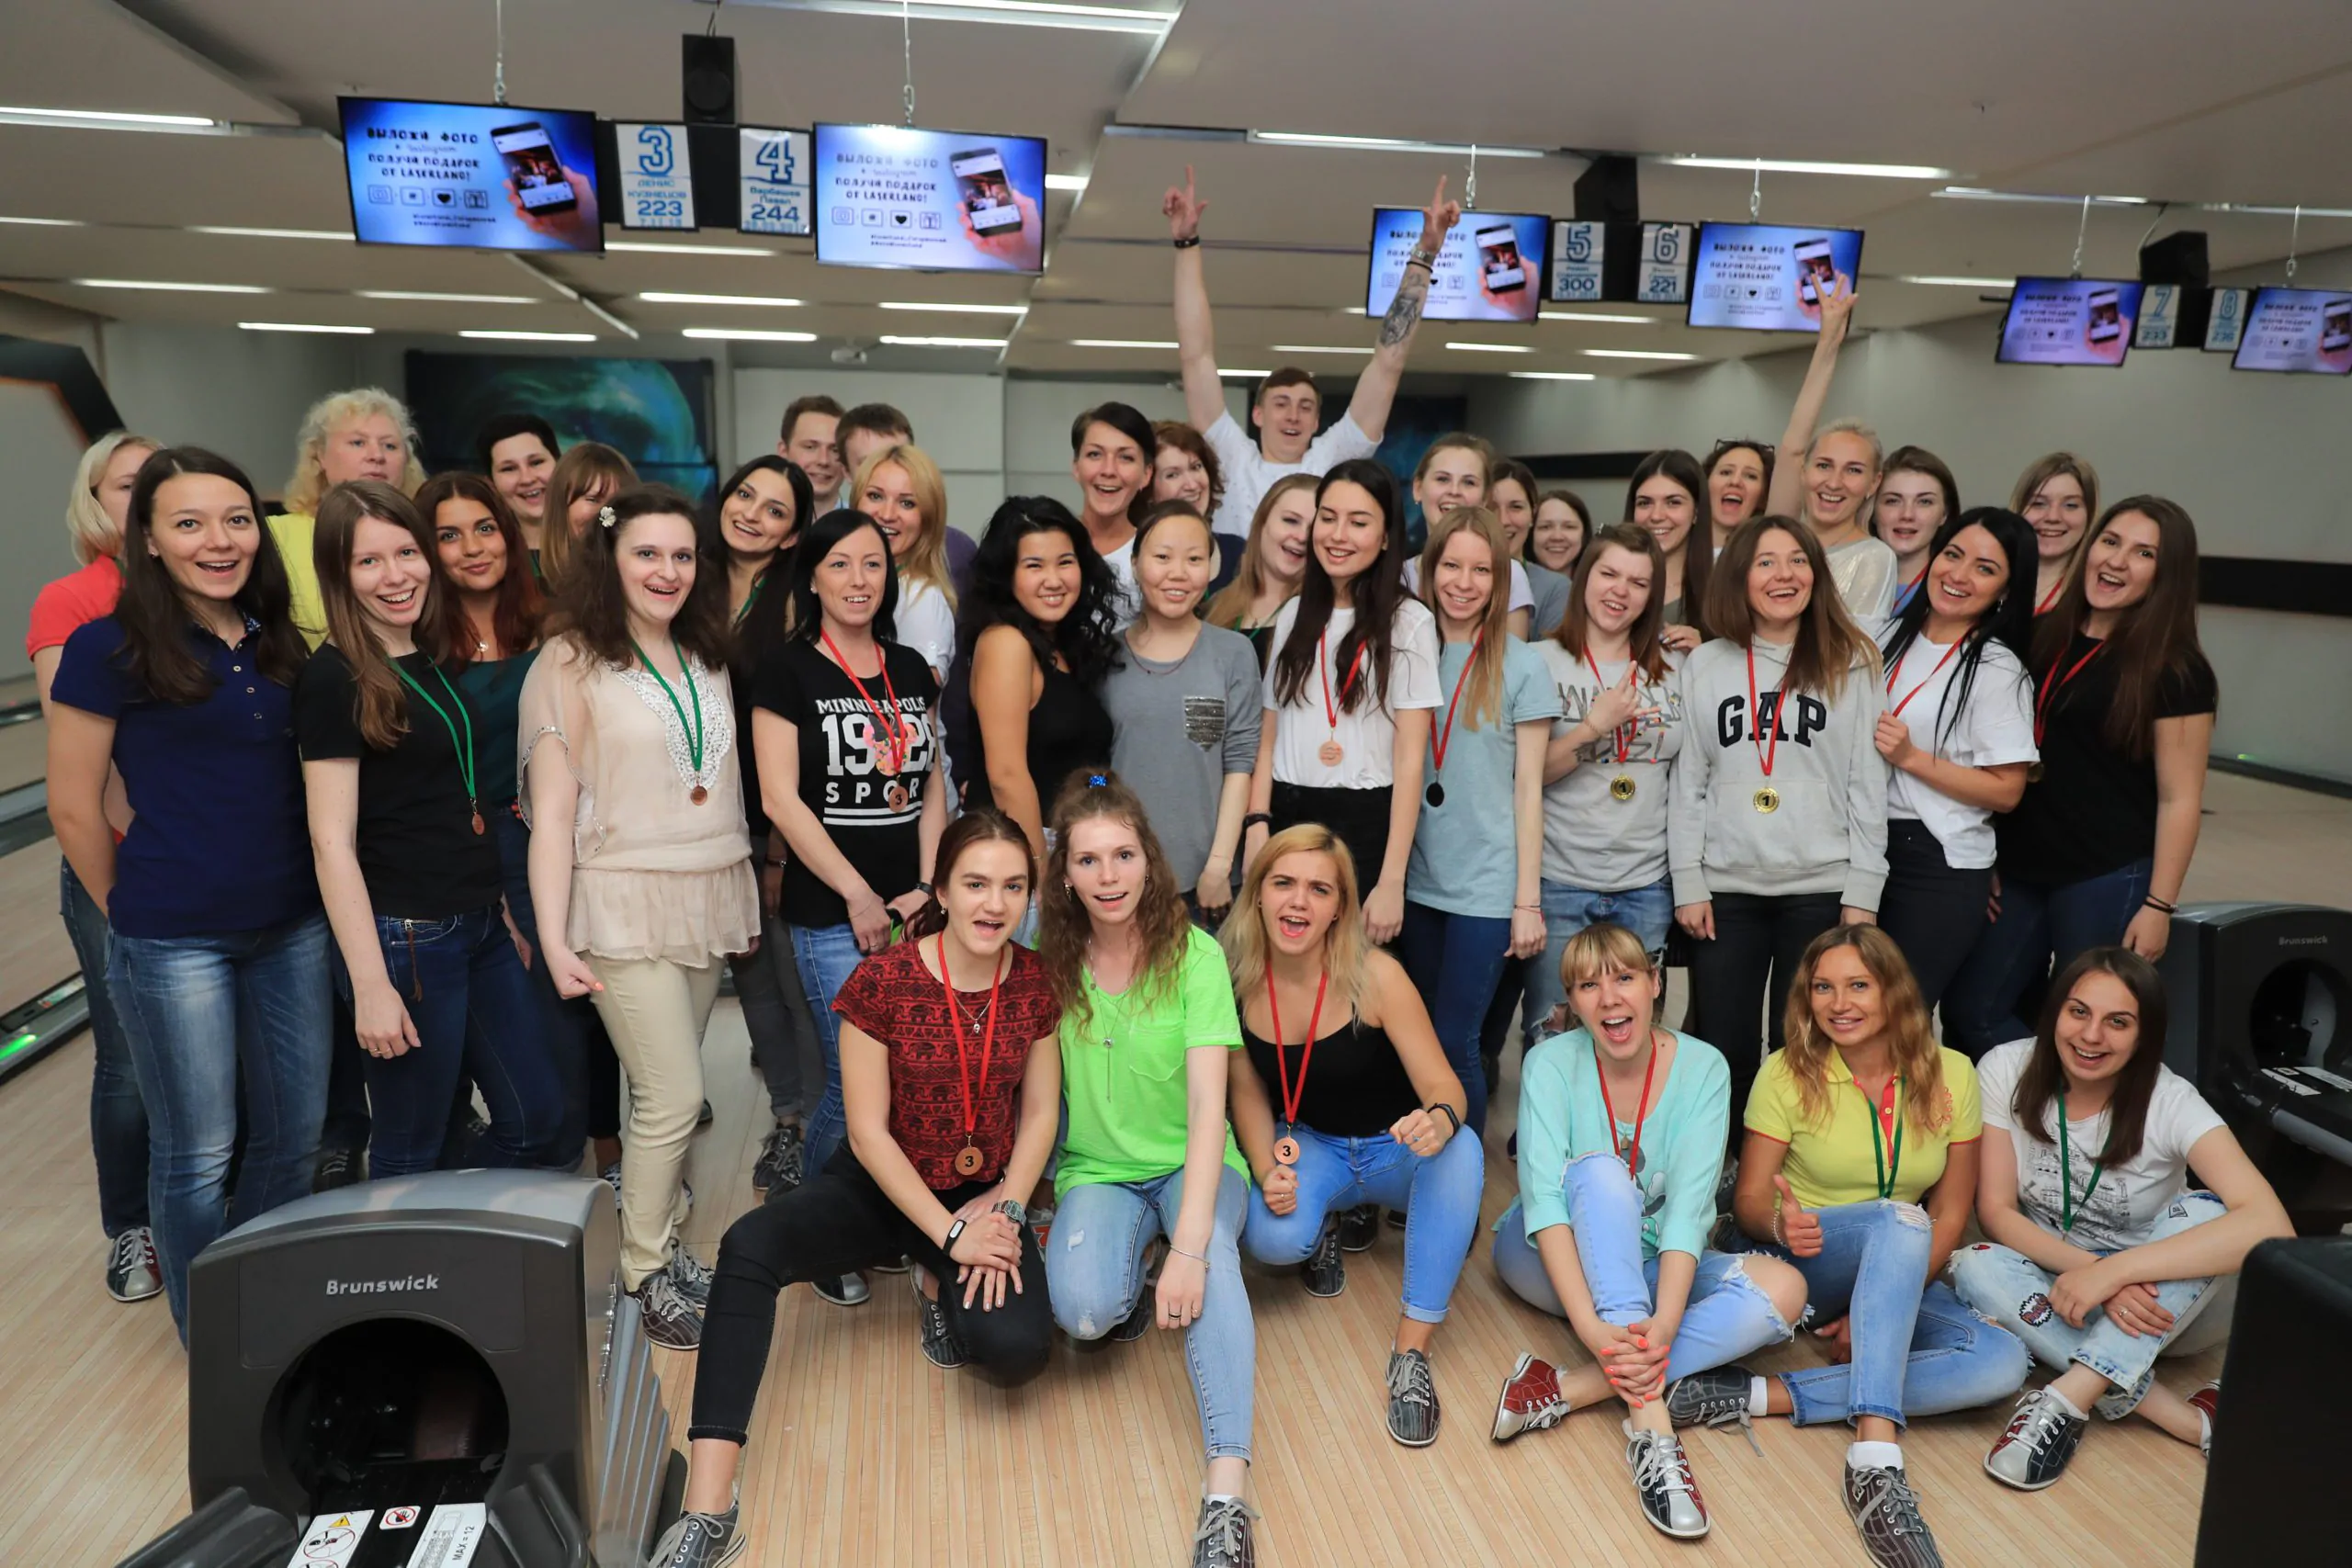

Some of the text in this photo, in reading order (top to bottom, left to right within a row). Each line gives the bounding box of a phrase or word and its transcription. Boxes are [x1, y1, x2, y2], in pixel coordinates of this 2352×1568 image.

[367, 127, 479, 144] ВЫЛОЖИ ФОТО
[638, 125, 673, 177] 3
[368, 153, 481, 169] ПОЛУЧИ ПОДАРОК
[755, 138, 796, 184] 4
[836, 152, 939, 169] ВЫЛОЖИ ФОТО
[381, 168, 470, 182] ОТ LASERLAND!
[835, 177, 937, 191] ПОЛУЧИ ПОДАРОК
[845, 190, 928, 203] ОТ LASERLAND!
[638, 199, 684, 217] 223
[751, 203, 800, 222] 244
[1447, 232, 1467, 242] ОТО
[1566, 224, 1591, 263] 5
[1654, 224, 1679, 264] 6
[1559, 277, 1595, 291] 300
[1649, 277, 1677, 293] 221
[2154, 285, 2172, 316] 7
[2220, 289, 2238, 320] 8
[1717, 692, 1826, 748] GAP
[1761, 795, 1770, 807] 1
[1282, 1145, 1292, 1157] 3
[965, 1156, 975, 1168] 3
[325, 1274, 439, 1295] Brunswick
[451, 1543, 468, 1561] MAX
[463, 1526, 475, 1535] 12
